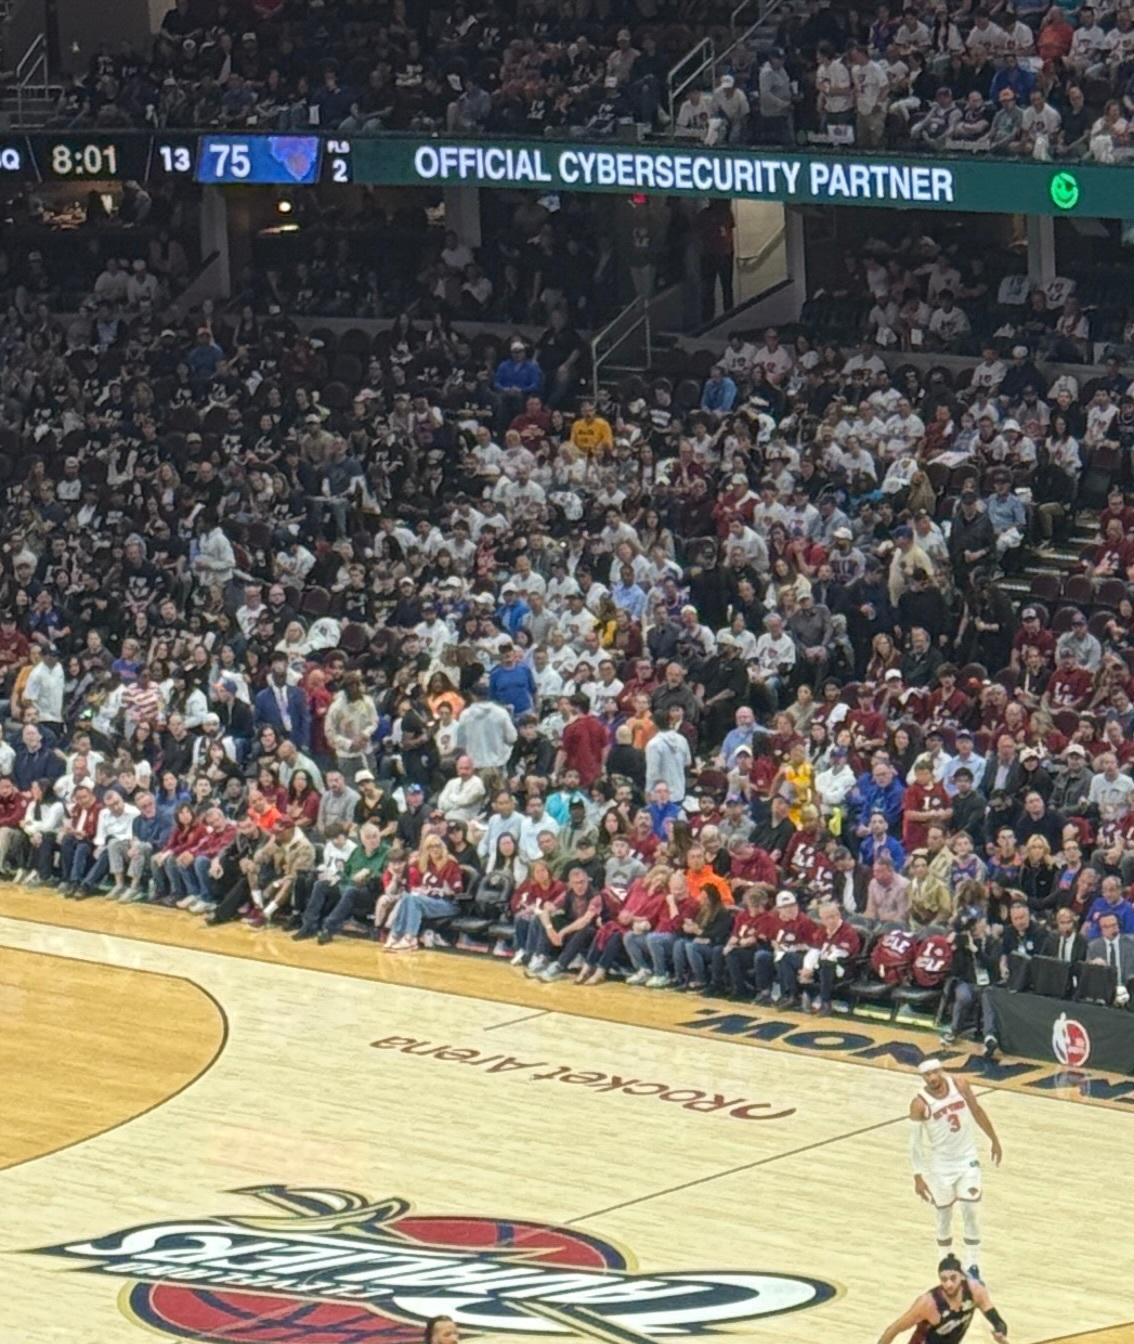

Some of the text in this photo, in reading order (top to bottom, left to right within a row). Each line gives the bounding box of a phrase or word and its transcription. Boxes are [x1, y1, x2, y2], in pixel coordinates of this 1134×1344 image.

[52, 144, 117, 174] 8:01
[160, 145, 191, 171] 13
[209, 143, 251, 178] 75
[332, 160, 348, 182] 2
[414, 145, 955, 203] OFFICIAL CYBERSECURITY PARTNER
[369, 1034, 745, 1114] Rocket Arena
[945, 1114, 962, 1135] 3
